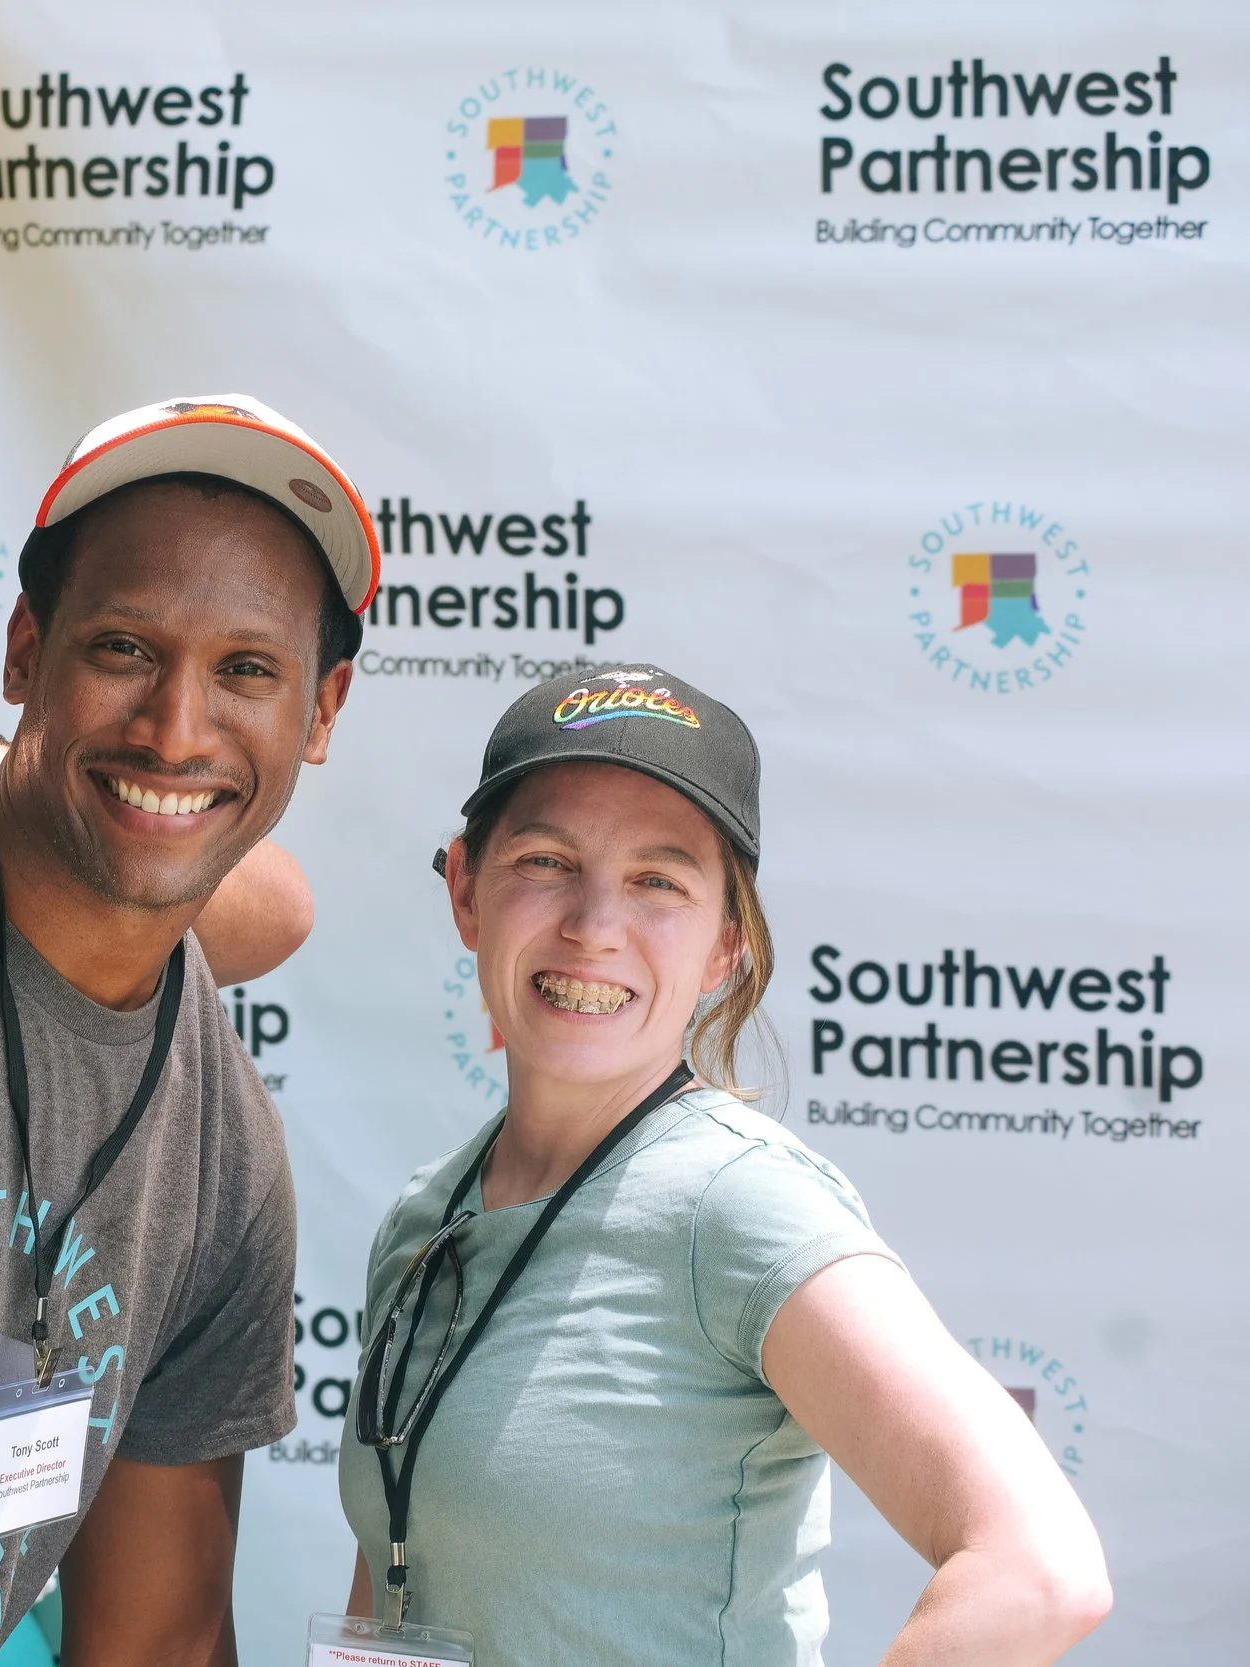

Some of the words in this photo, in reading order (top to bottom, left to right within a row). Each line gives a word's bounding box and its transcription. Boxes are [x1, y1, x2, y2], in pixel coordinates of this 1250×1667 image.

[445, 67, 618, 138] SOUTHWEST
[820, 56, 1178, 122] Southwest
[822, 130, 1211, 206] Partnership
[23, 222, 154, 250] Community
[160, 221, 269, 250] Together
[445, 171, 612, 250] PARTNERSHIP
[816, 218, 917, 247] Building
[923, 216, 1082, 245] Community
[1088, 215, 1209, 245] Together
[376, 498, 591, 557] thwest
[908, 501, 1089, 574] SOUTHWEST
[368, 572, 624, 645] nership
[359, 650, 506, 682] Community
[511, 654, 623, 680] Togeth
[910, 611, 1086, 694] PARTNERSHIP
[553, 687, 700, 727] Orioles
[809, 944, 1171, 1014] Southwest
[811, 1017, 1204, 1103] Partnership
[807, 1100, 909, 1133] Building
[915, 1103, 1074, 1140] Community
[1081, 1111, 1202, 1142] Together
[966, 1336, 1087, 1412] THWEST
[0, 1466, 35, 1484] Executive
[36, 1460, 66, 1475] Director
[11, 1446, 33, 1458] Tony
[35, 1436, 59, 1452] Scott
[30, 1472, 70, 1490] Partnership
[368, 1657, 396, 1667] return
